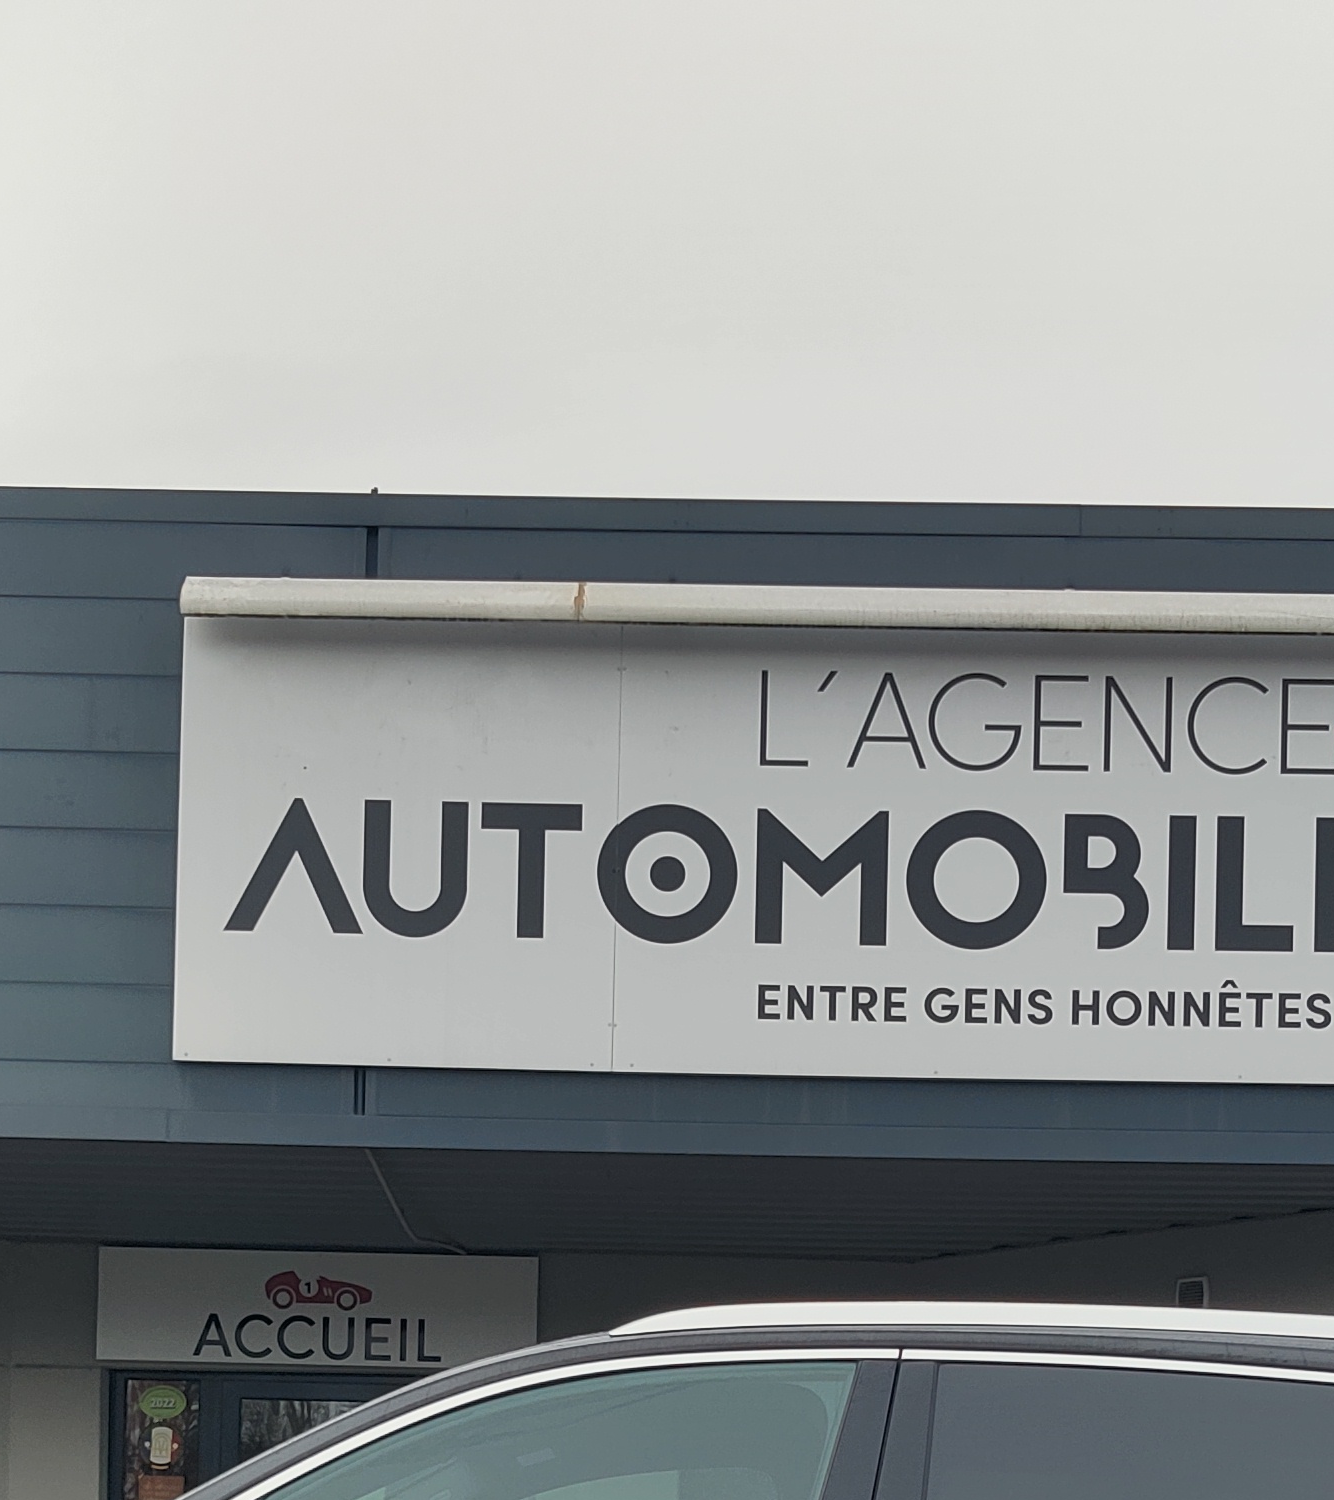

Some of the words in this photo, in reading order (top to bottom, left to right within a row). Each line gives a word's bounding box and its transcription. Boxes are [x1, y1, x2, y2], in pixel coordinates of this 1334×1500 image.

[757, 984, 907, 1023] ENTRE
[924, 987, 1053, 1025] GENS
[1071, 979, 1332, 1029] HONNÊTES
[192, 1312, 442, 1363] ACCUEIL
